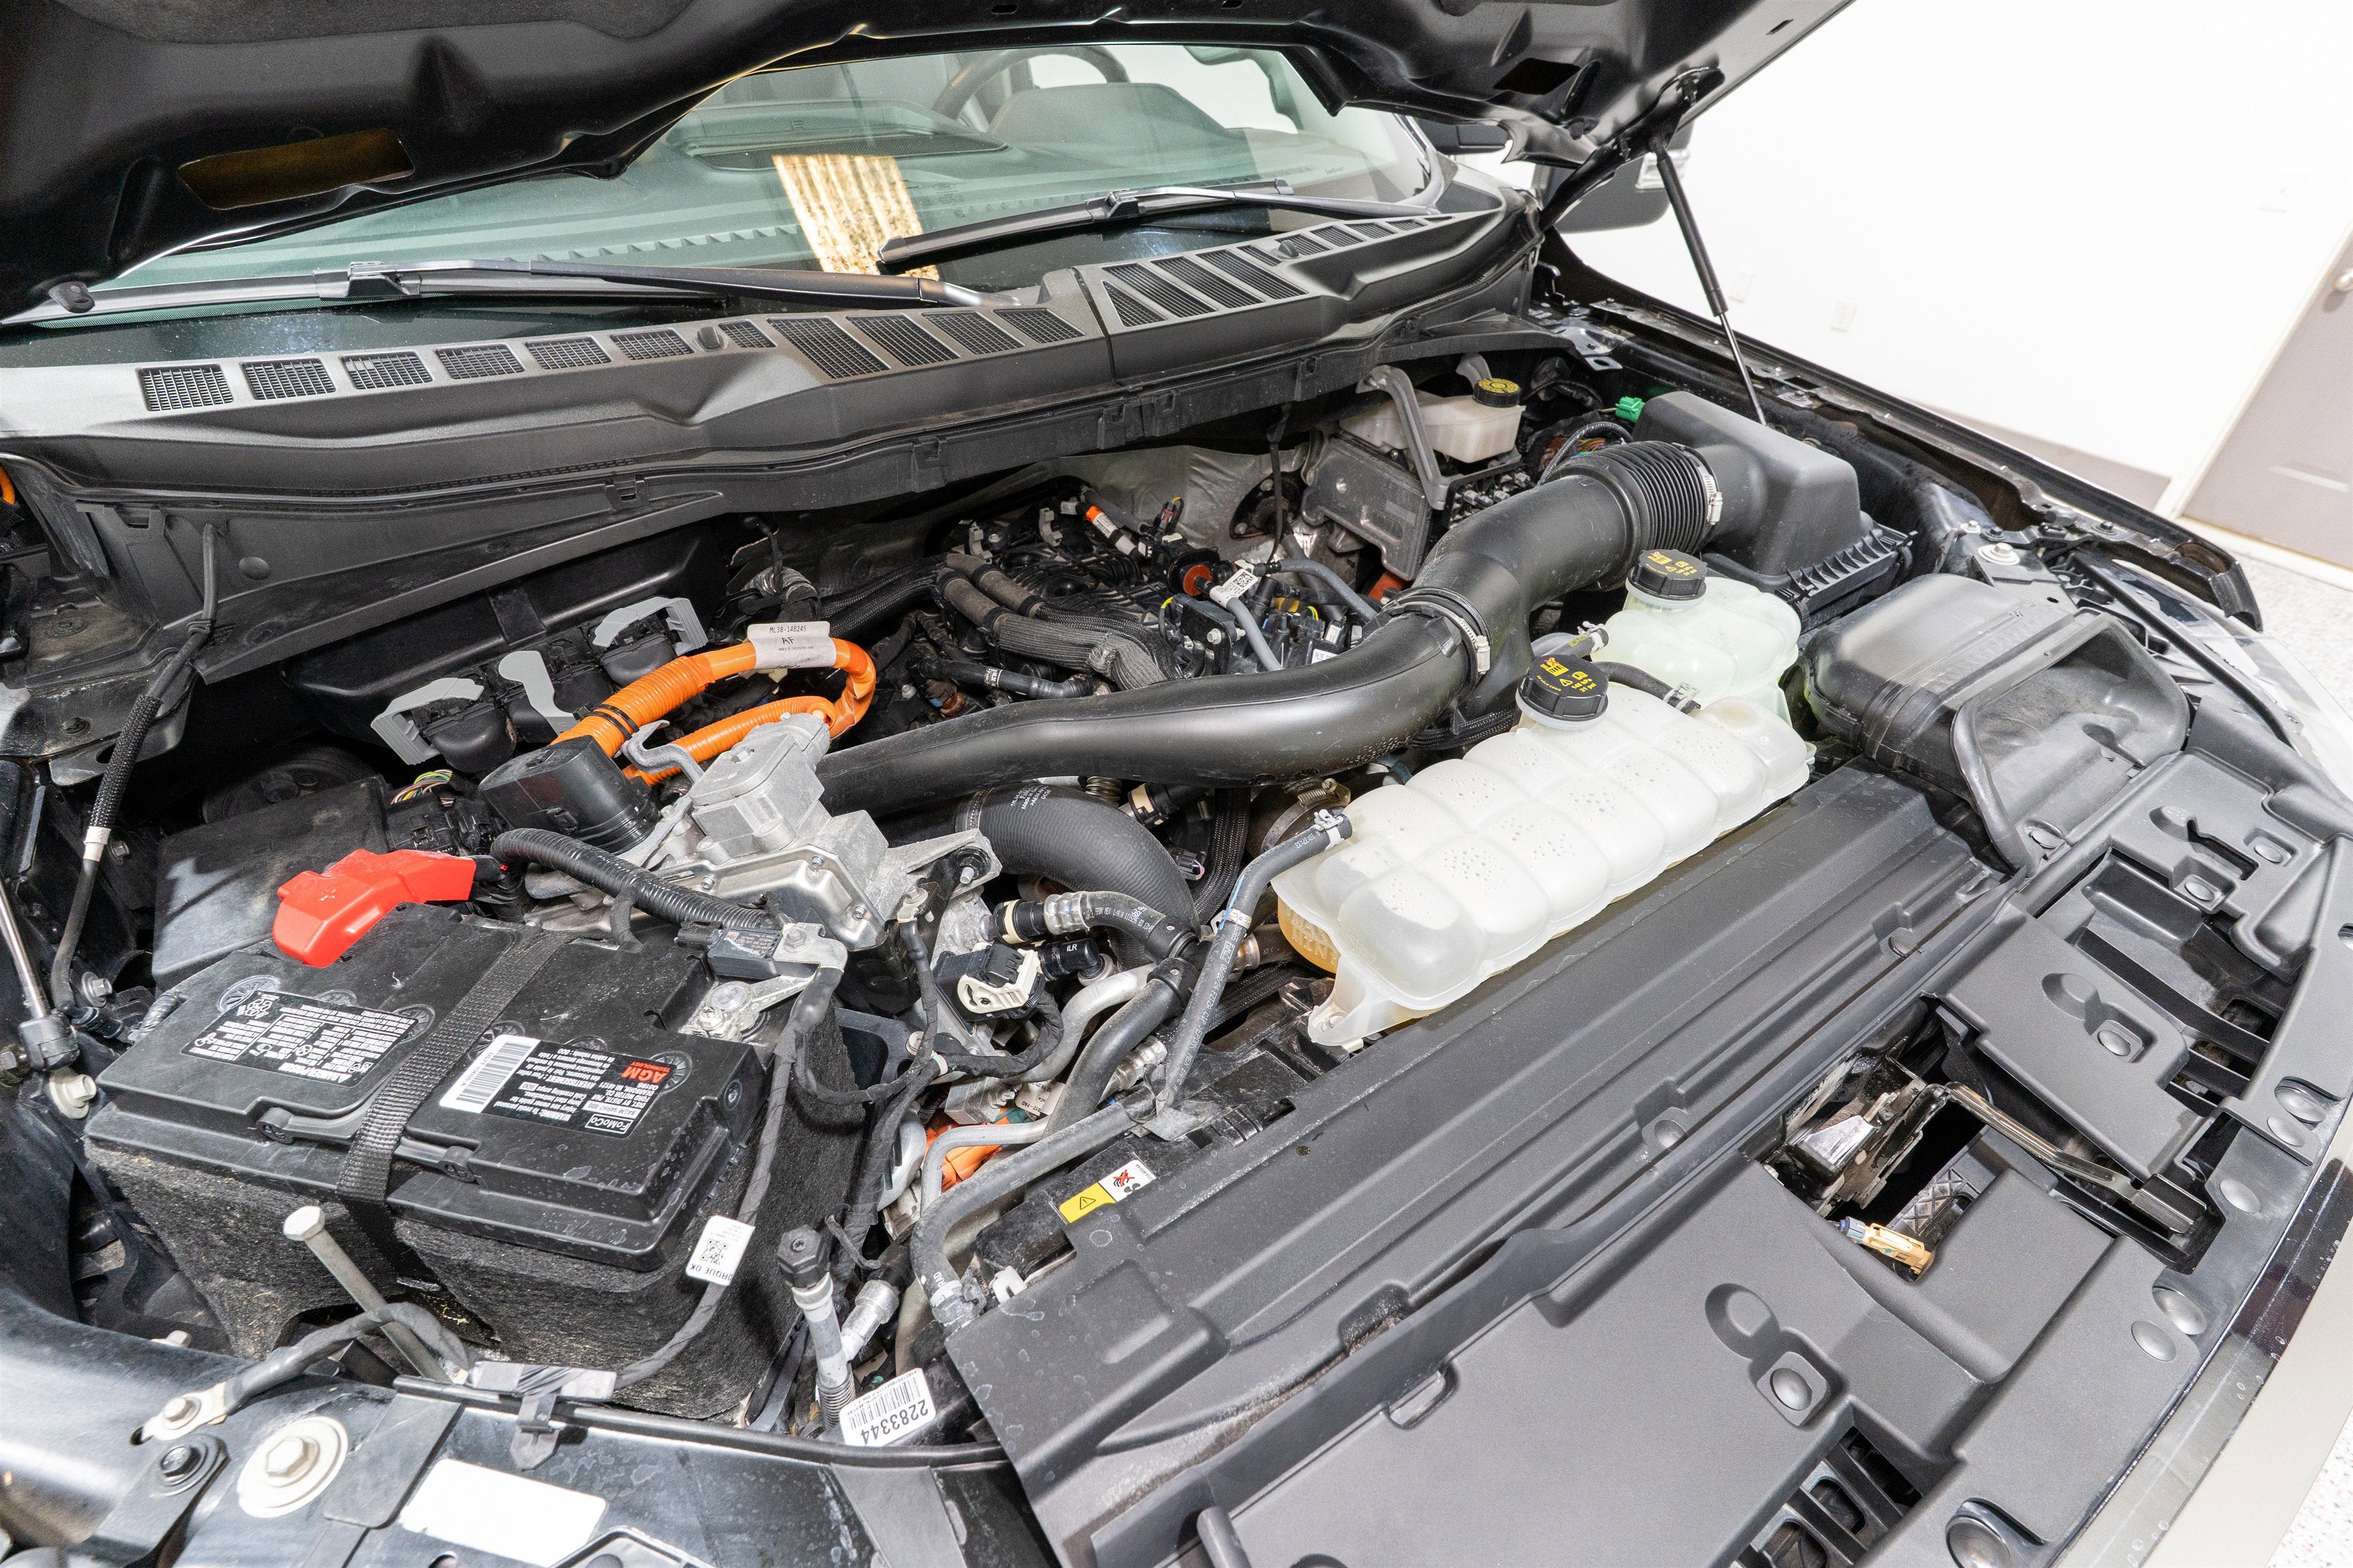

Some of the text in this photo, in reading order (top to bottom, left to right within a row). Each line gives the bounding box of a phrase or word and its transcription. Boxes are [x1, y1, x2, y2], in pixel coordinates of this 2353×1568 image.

[769, 625, 807, 634] ML38-14B245
[781, 636, 794, 644] AF
[1294, 833, 1315, 848] 10:37:33
[1213, 964, 1226, 990] 06/22/24
[1183, 1053, 1193, 1066] MEX
[630, 1061, 669, 1072] TECHNOLOGY
[622, 1067, 666, 1082] AGM
[546, 1075, 595, 1088] AVERTISSEMENT
[551, 1087, 574, 1096] cranking
[624, 1086, 654, 1096] DEARBORN,
[604, 1096, 623, 1104] DISTR.
[539, 1109, 570, 1121] WARNING:
[589, 1117, 630, 1130] FoMoCo
[933, 1272, 946, 1289] RAD
[861, 1400, 932, 1445] 2283344
